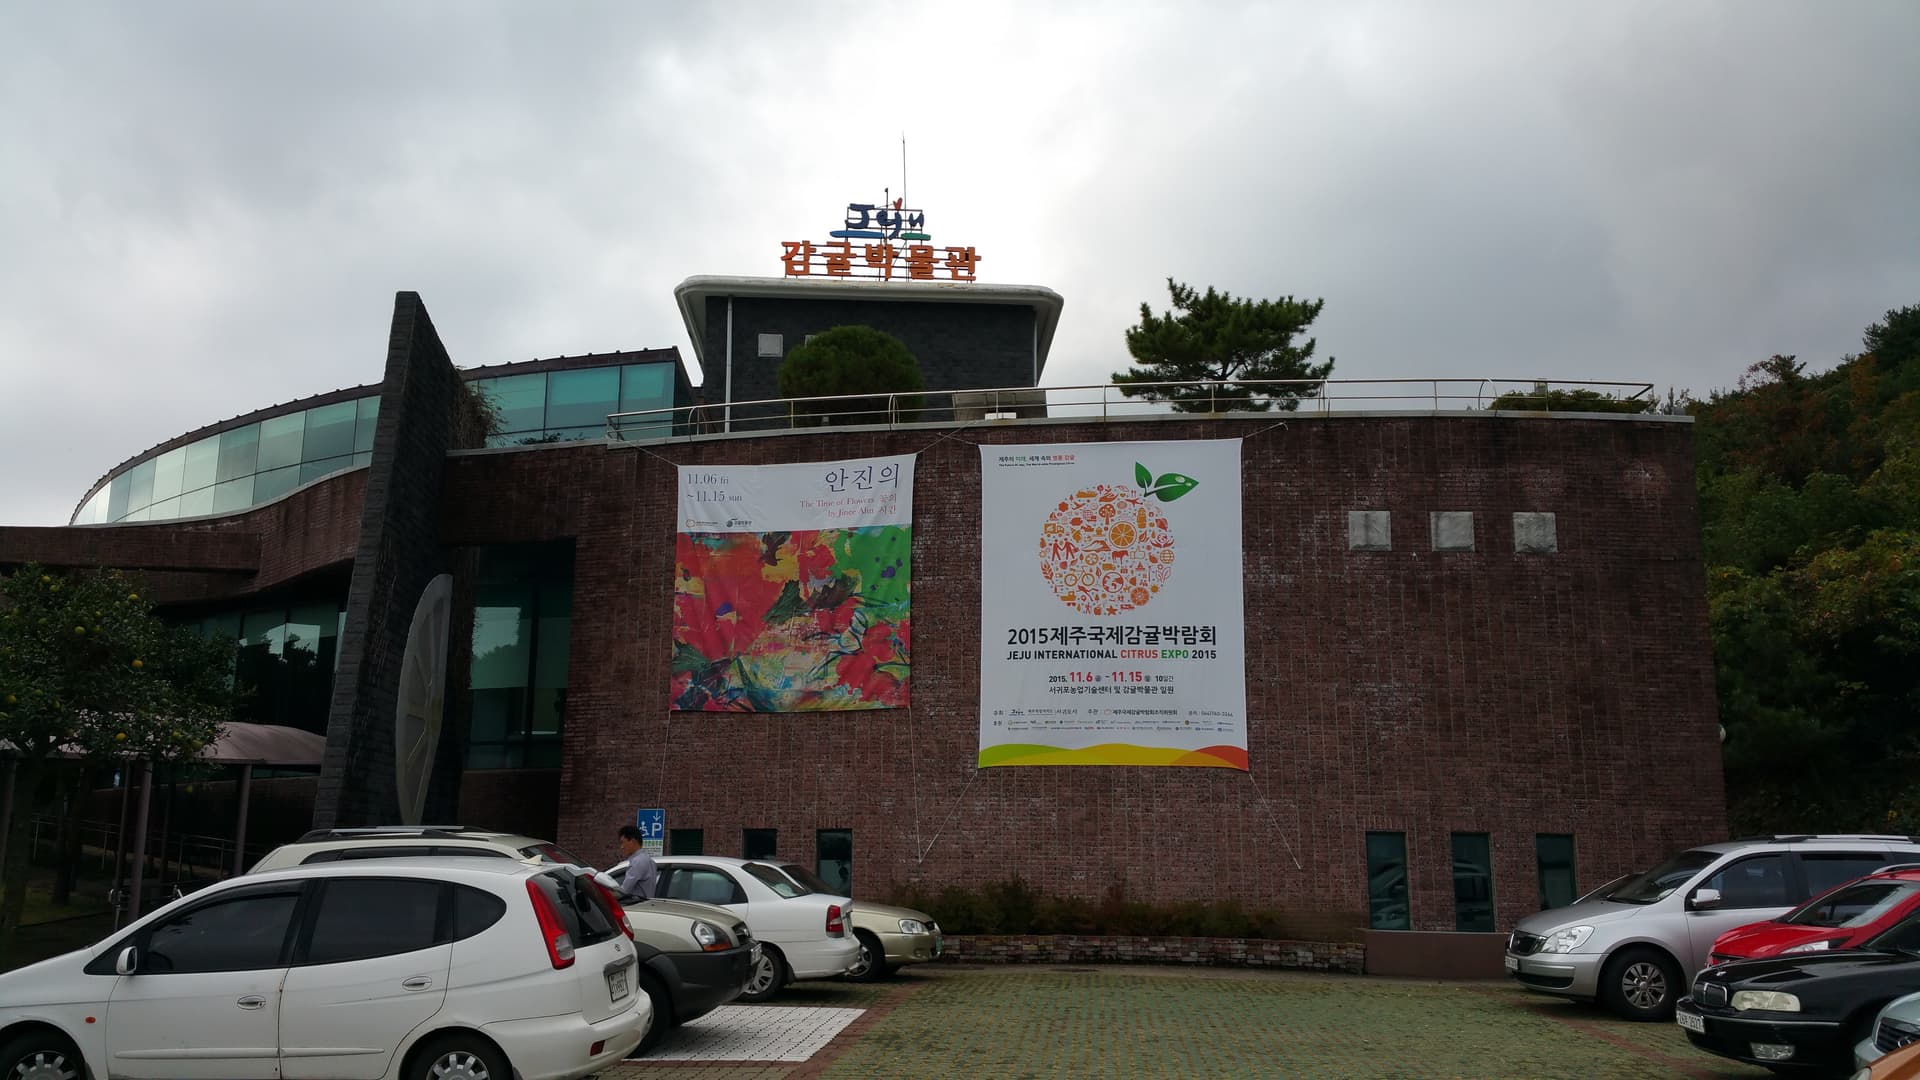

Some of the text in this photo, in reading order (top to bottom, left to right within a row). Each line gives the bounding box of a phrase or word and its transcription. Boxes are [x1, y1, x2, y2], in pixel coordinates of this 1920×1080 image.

[781, 240, 982, 281] 감귤박물관
[688, 473, 717, 485] 11.06
[825, 463, 899, 492] 안진의
[800, 499, 814, 508] The
[816, 498, 833, 508] Time
[847, 496, 875, 506] Flowers
[1007, 625, 1216, 646] 2015제주국제감귤박람회
[1006, 649, 1216, 660] JEJU INTERNATIONAL CITRUS EXPO 2015
[1048, 675, 1067, 683] 2015.
[1069, 671, 1093, 683] 11.6
[1048, 685, 1112, 695] 서귀포농업기술센터
[1114, 685, 1121, 695] 및
[1123, 685, 1158, 695] 감귤박물관
[651, 822, 662, 837] P
